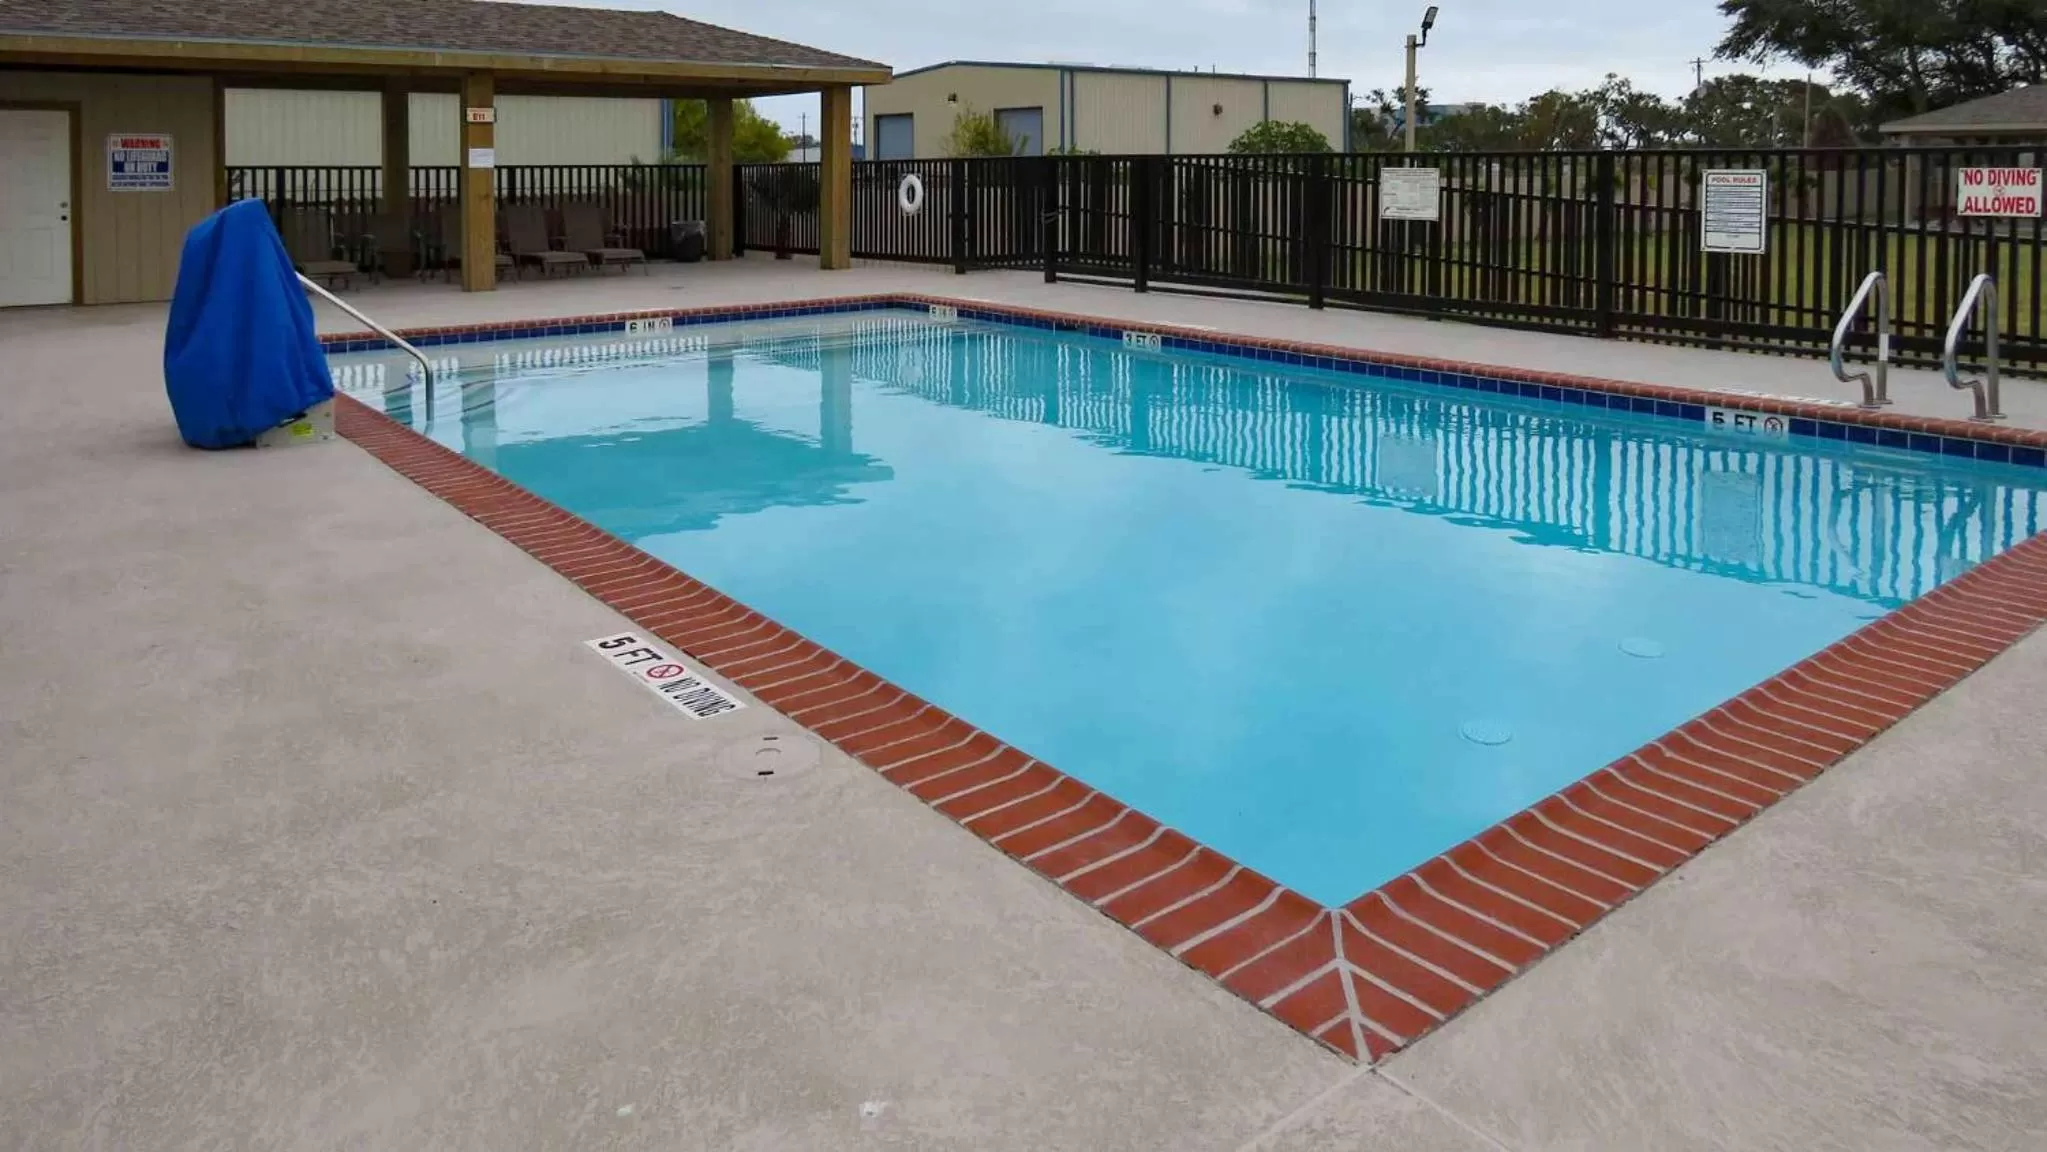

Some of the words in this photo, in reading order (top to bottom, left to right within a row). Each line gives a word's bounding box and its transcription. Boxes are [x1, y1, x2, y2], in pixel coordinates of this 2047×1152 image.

[121, 137, 161, 149] WARNING
[1711, 176, 1731, 184] POOL
[1732, 176, 1758, 184] RULES
[1964, 169, 1984, 186] NO
[1988, 169, 2037, 186] DIVING
[1963, 196, 2036, 214] ALLOWED
[1734, 414, 1758, 429] FT
[599, 636, 637, 650] 5
[613, 647, 664, 666] FT
[658, 676, 702, 694] NO
[672, 686, 737, 718] DIVING
